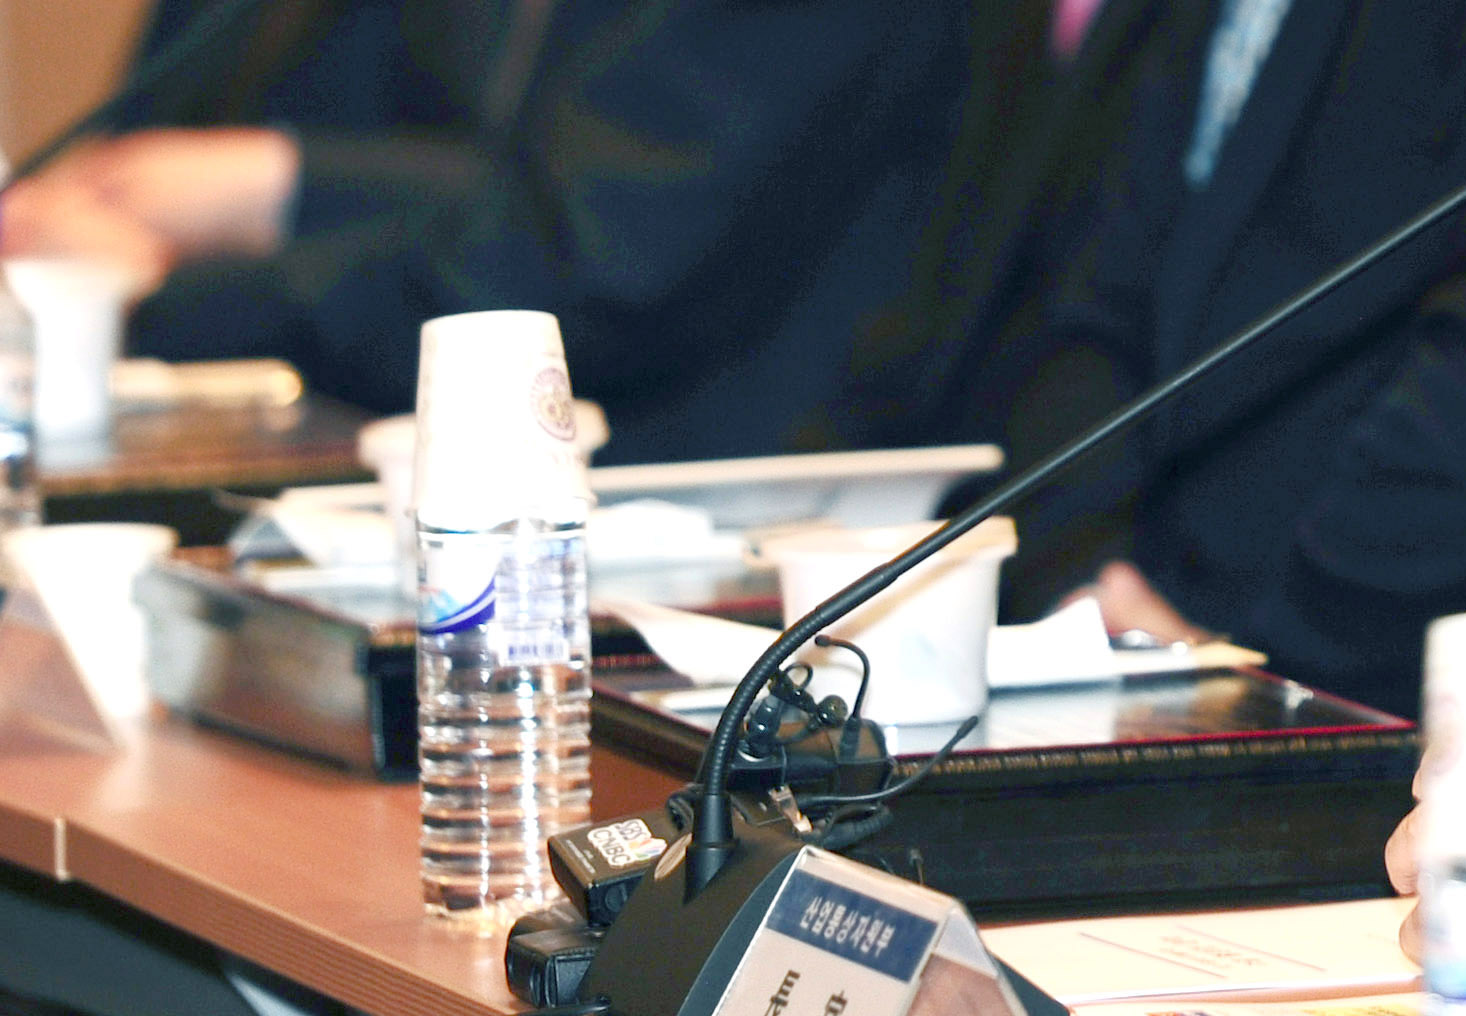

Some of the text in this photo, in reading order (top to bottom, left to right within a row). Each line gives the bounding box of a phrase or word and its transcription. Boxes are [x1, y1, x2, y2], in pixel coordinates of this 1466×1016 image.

[593, 829, 631, 864] CNBC
[613, 820, 647, 841] SBS
[800, 895, 896, 958] 산업통상자원부
